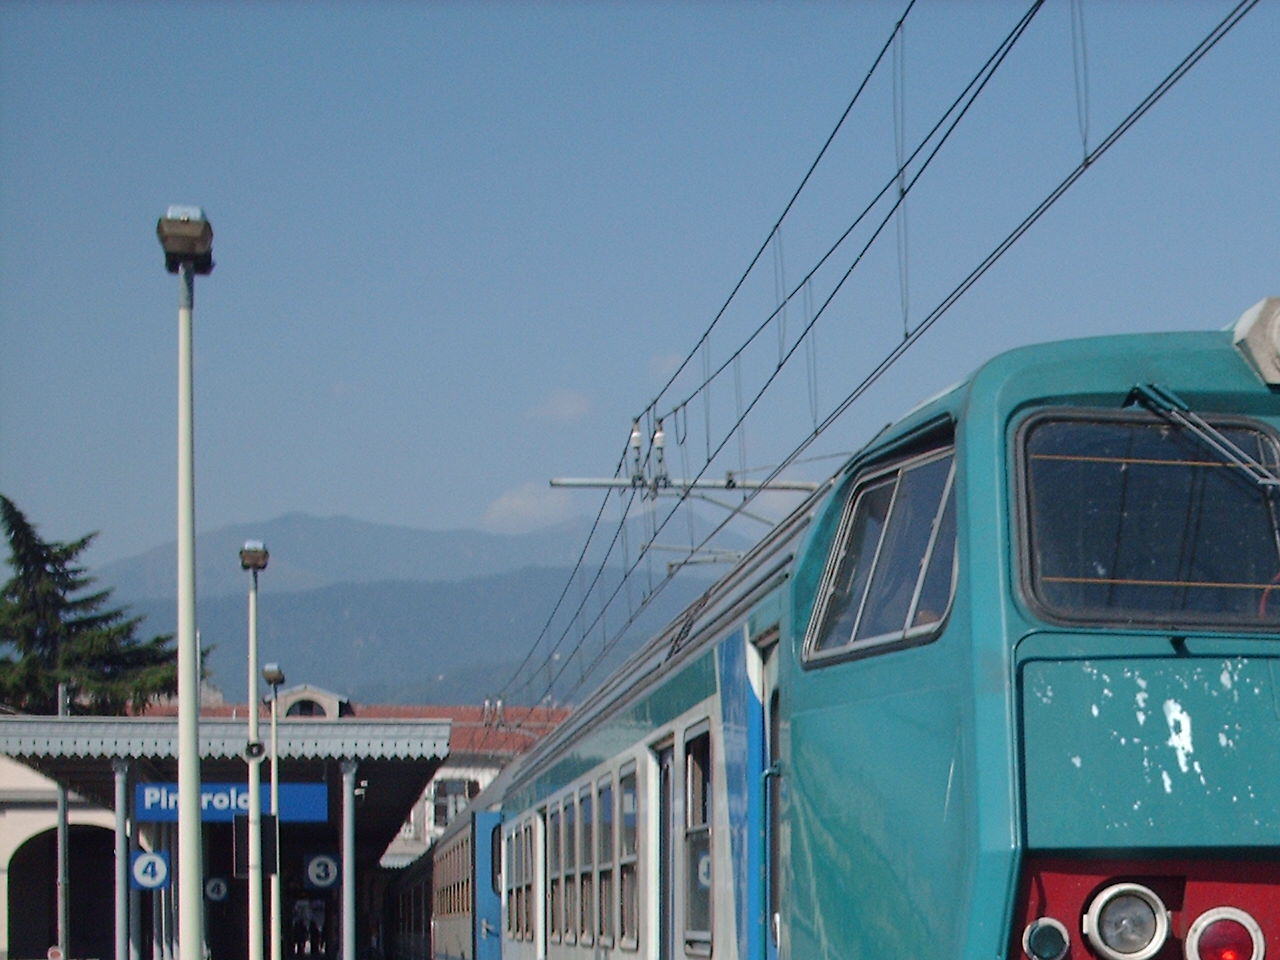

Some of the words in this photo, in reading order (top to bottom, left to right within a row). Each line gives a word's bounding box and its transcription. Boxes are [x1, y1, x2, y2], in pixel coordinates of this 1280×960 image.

[144, 787, 249, 810] Pinrolo
[142, 861, 157, 879] 4
[315, 863, 330, 881] 3
